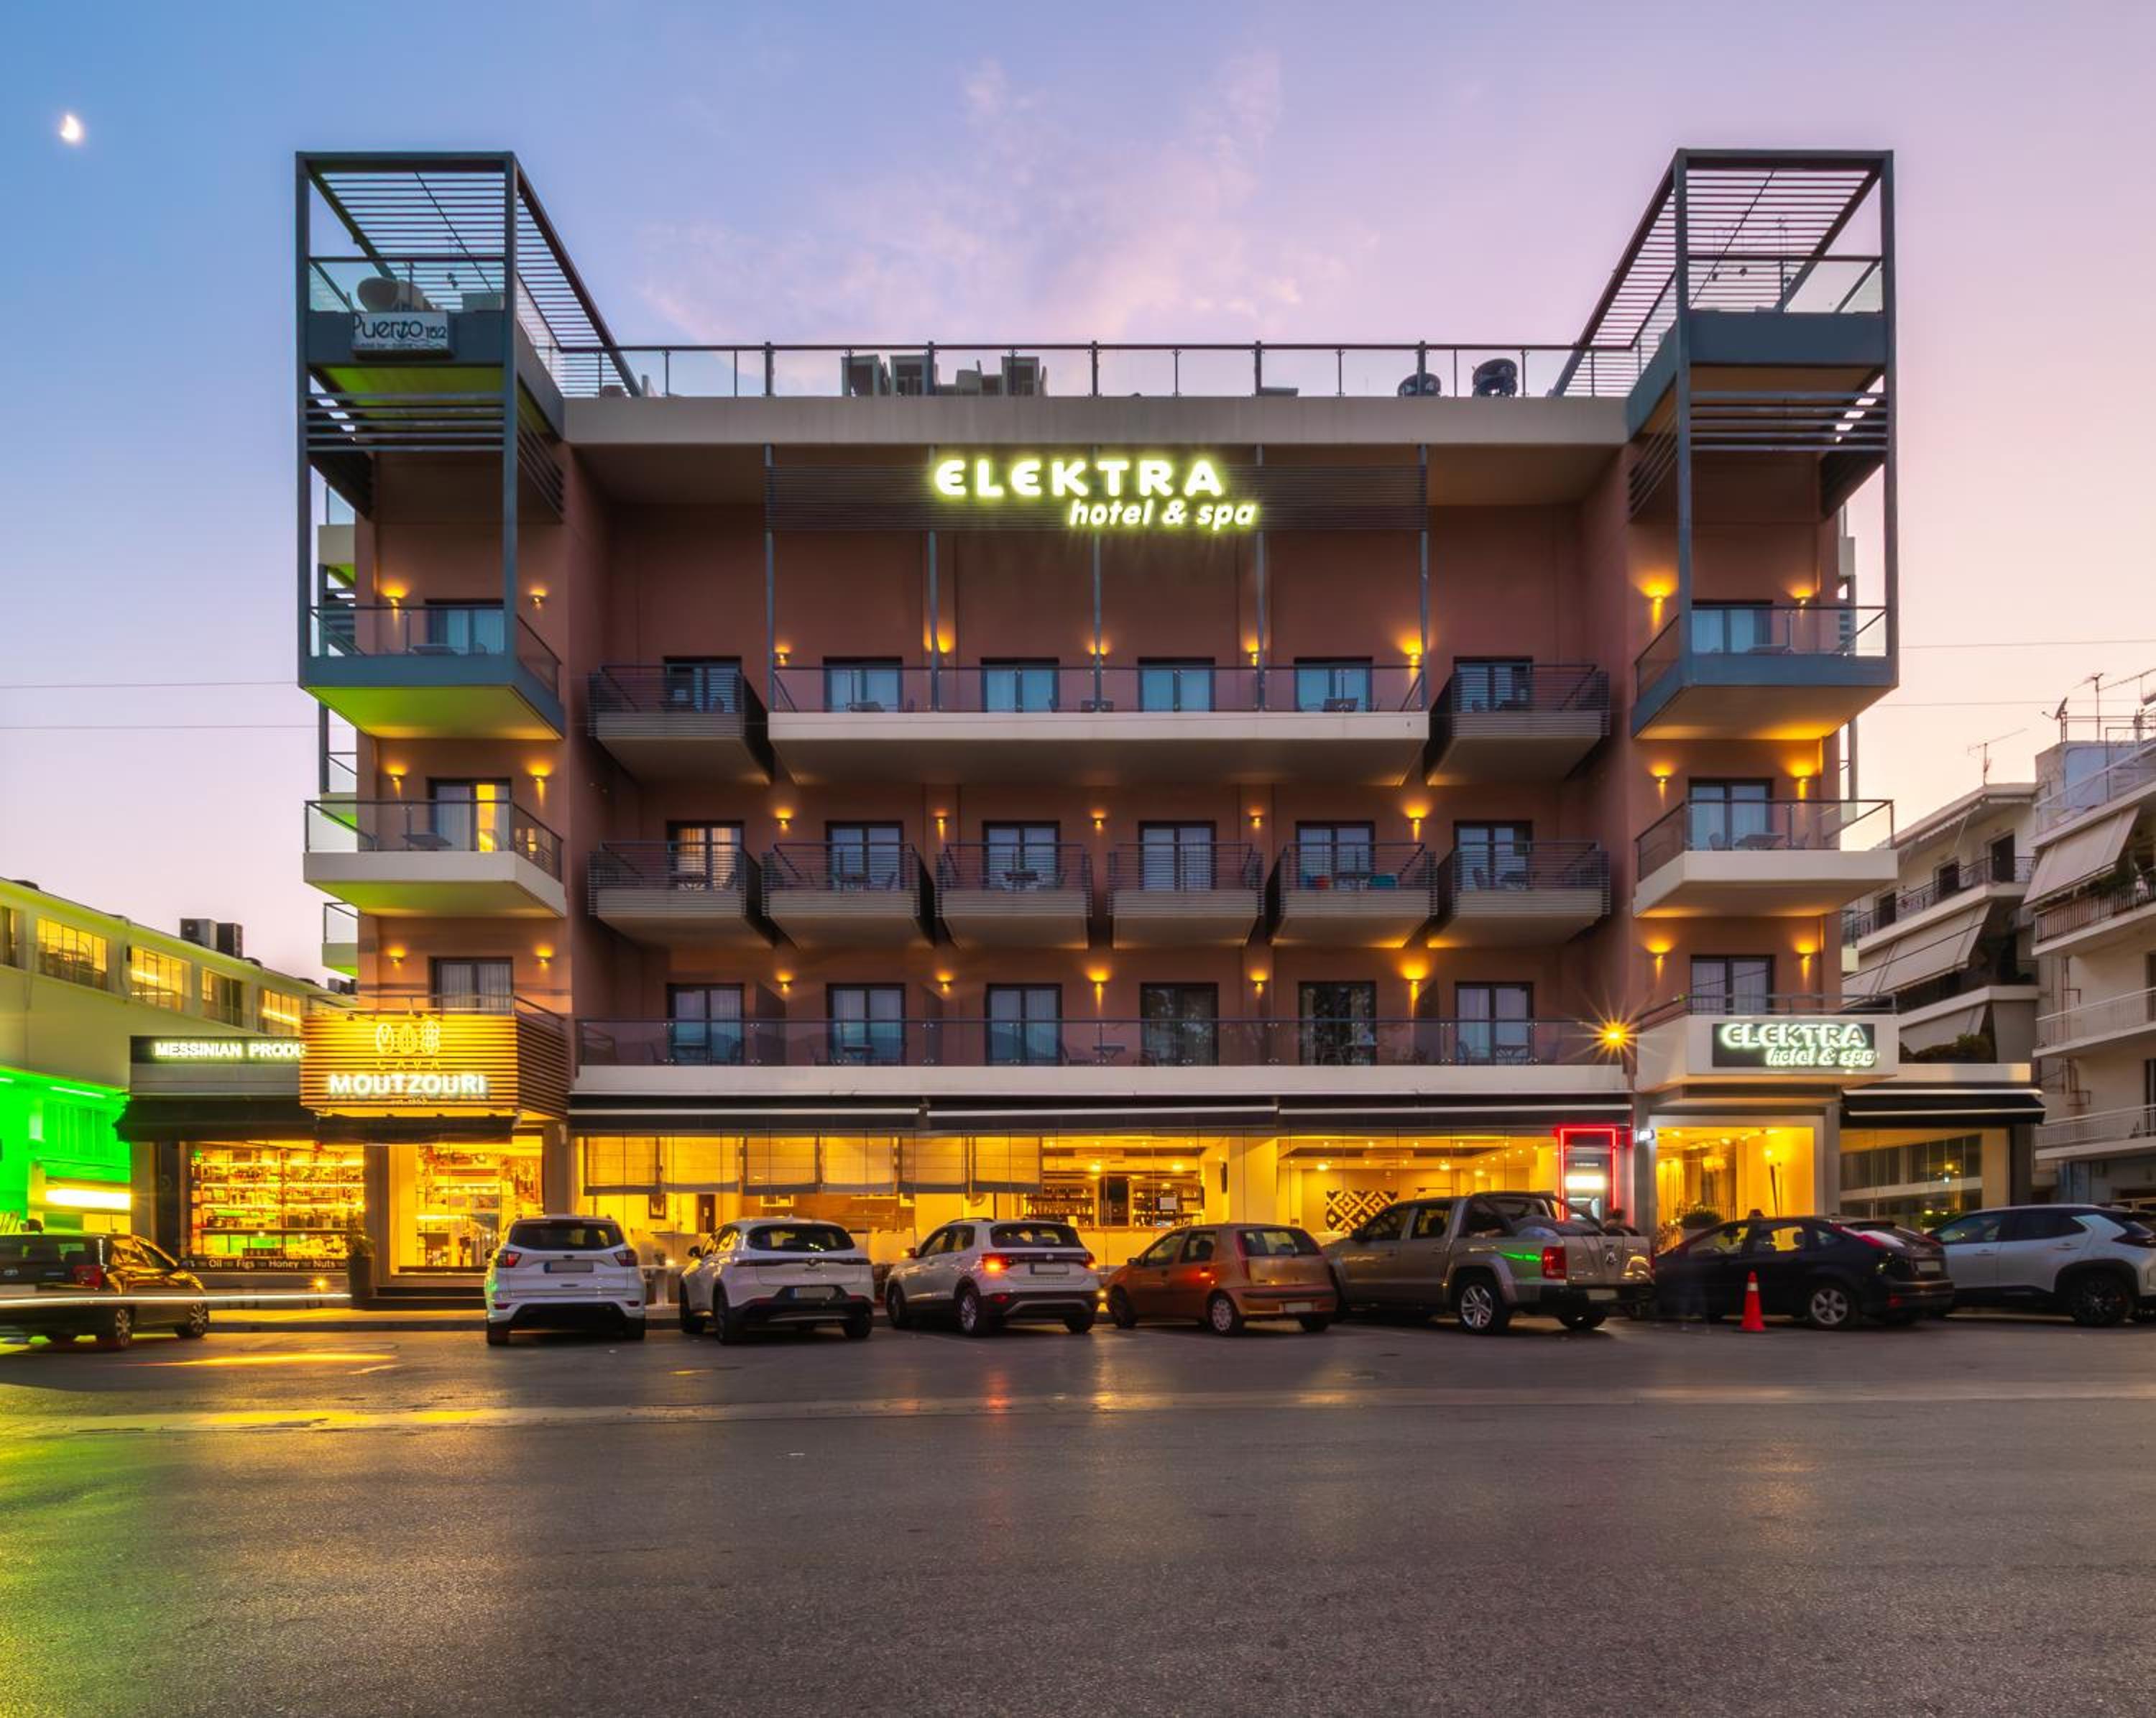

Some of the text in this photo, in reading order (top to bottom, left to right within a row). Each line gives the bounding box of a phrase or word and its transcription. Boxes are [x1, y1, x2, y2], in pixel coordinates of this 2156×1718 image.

[352, 312, 423, 340] Puerto
[935, 459, 1224, 497] ELEKTRA
[1068, 499, 1256, 530] hotel & spa
[1722, 1023, 1866, 1048] ELEKTRA
[154, 1042, 243, 1058] MESSINIAN
[1766, 1047, 1877, 1067] hotel & spa
[328, 1073, 488, 1095] MOUTZOURI
[208, 1259, 222, 1268] Oil
[236, 1259, 255, 1270] Figs
[268, 1259, 300, 1270] Honey
[313, 1259, 336, 1268] Nuts
